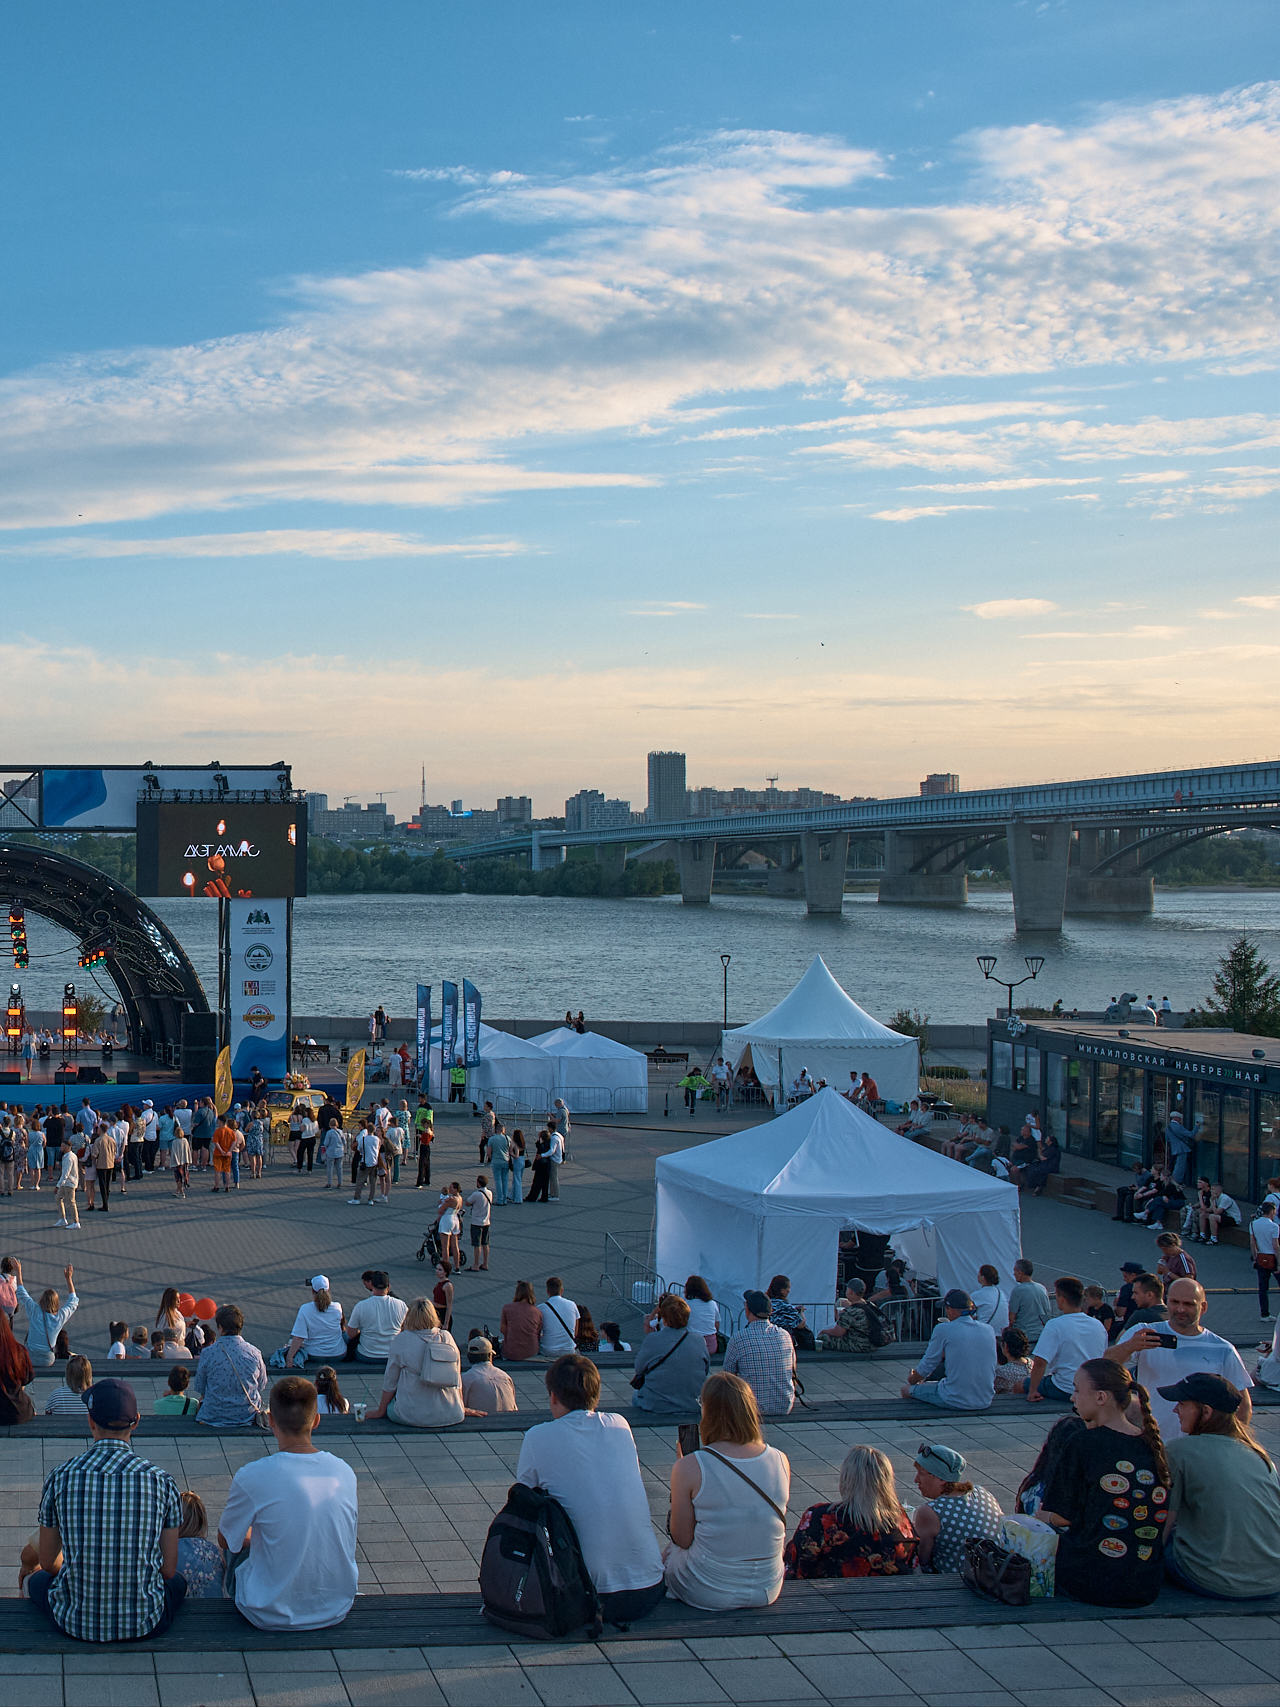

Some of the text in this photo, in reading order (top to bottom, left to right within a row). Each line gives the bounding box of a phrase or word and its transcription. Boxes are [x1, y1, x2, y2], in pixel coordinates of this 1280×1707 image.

[466, 1002, 476, 1038] ФЕСТИВАЛИ
[1078, 1044, 1165, 1066] МИХАЙЛОВСКАЯ
[1102, 1540, 1124, 1551] Dole
